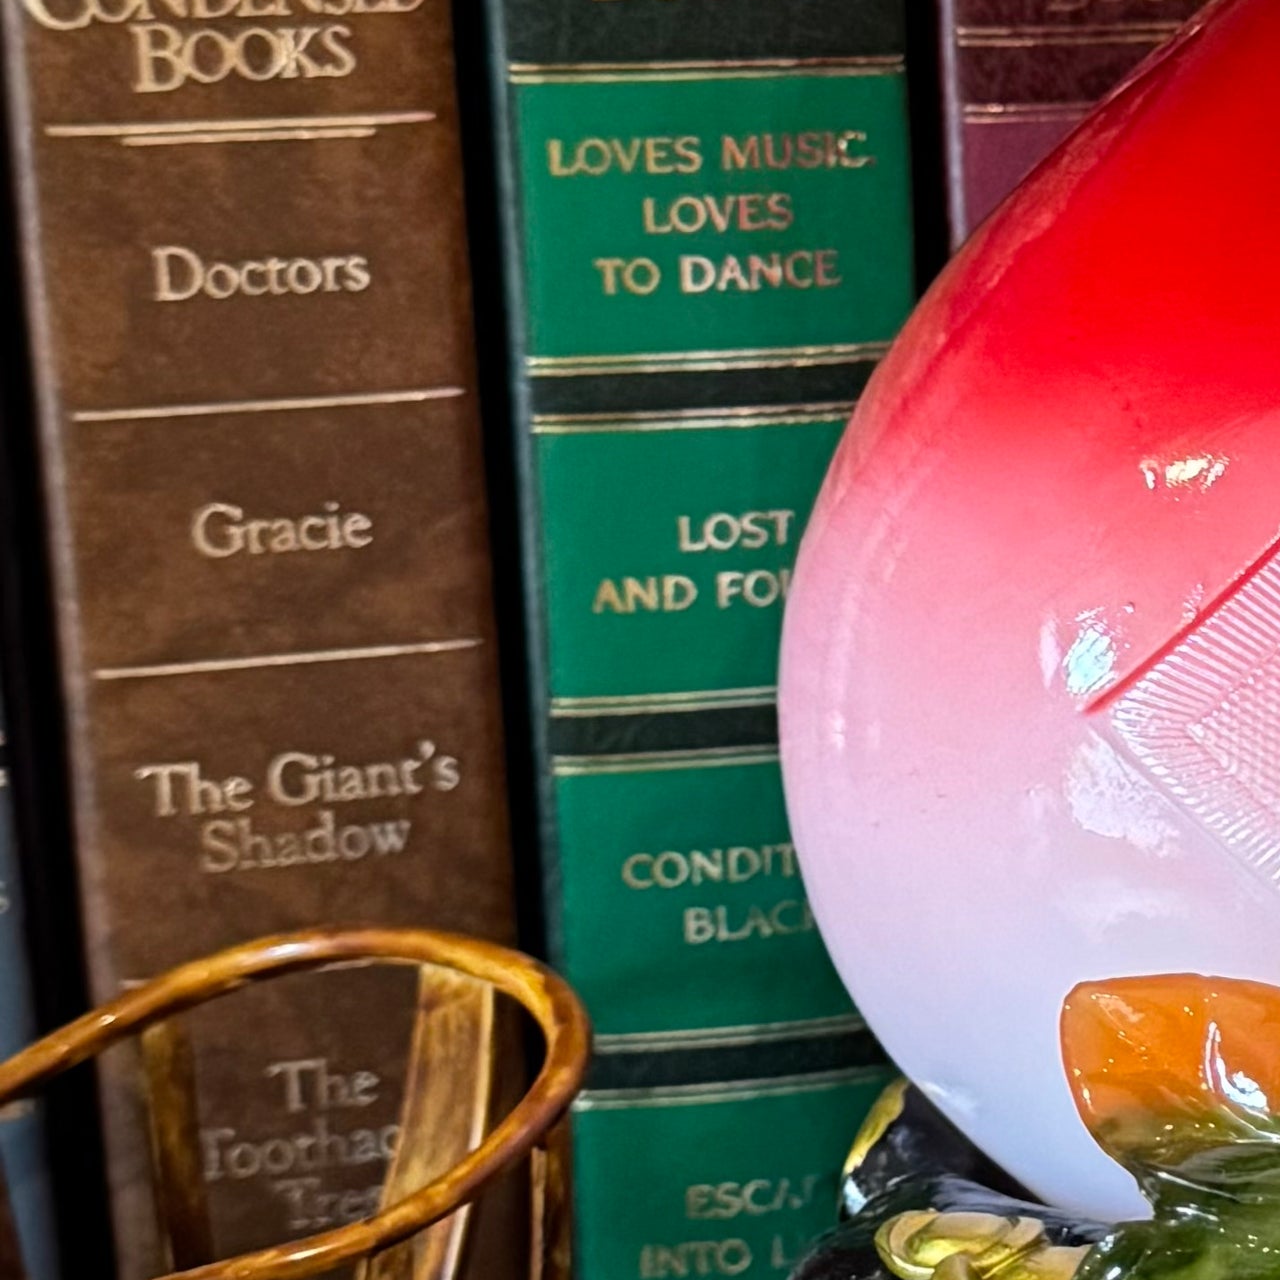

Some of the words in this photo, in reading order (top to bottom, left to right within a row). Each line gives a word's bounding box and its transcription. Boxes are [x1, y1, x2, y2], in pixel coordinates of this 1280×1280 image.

[131, 24, 355, 93] BOOKS
[547, 136, 703, 177] LOVES
[643, 193, 793, 234] LOVES
[153, 245, 371, 302] Doctors
[593, 257, 660, 295] TO
[679, 250, 841, 293] DANCE
[191, 502, 373, 558] Gracie
[678, 510, 795, 552] LOST
[593, 574, 698, 614] AND
[136, 763, 255, 817] The
[266, 741, 460, 808] Giant's
[202, 815, 411, 873] Shadow
[266, 1058, 380, 1113] The
[640, 1237, 752, 1279] INTO
